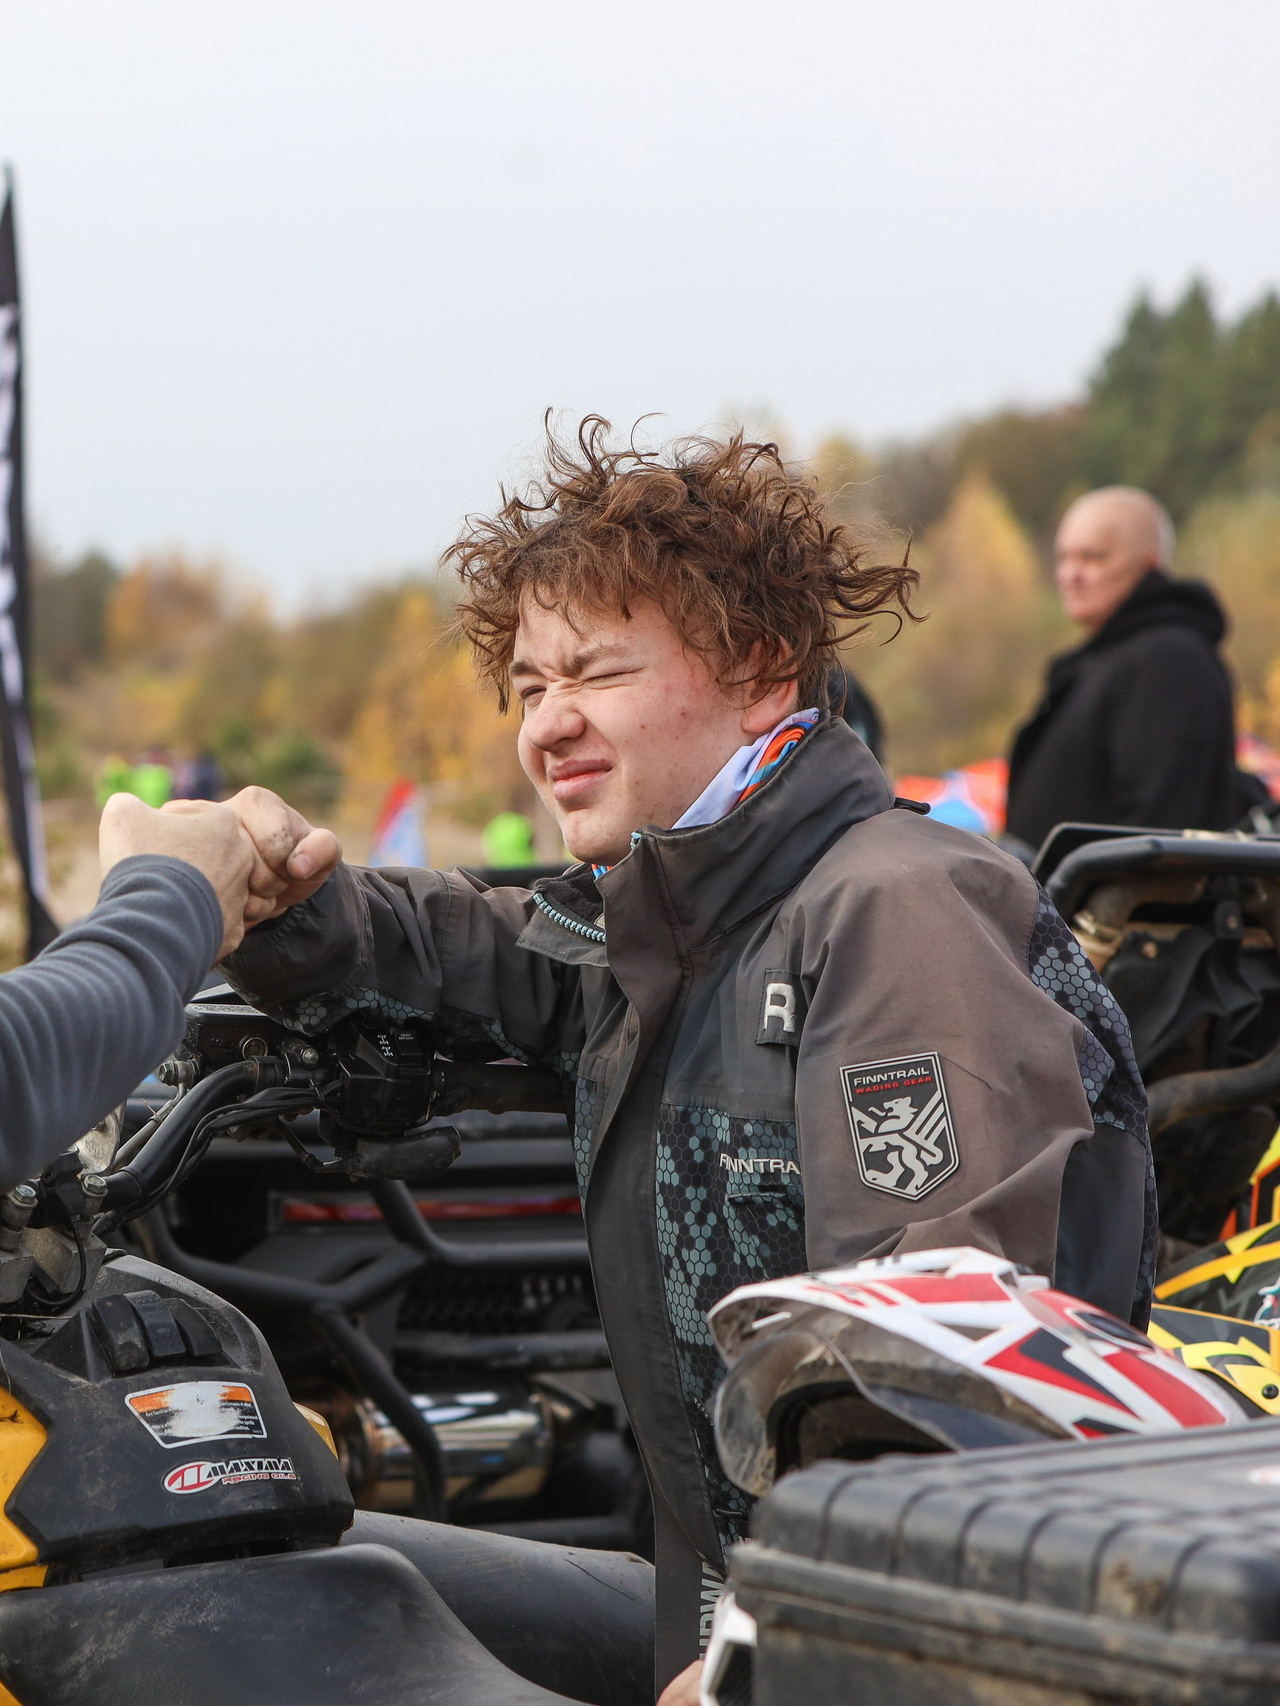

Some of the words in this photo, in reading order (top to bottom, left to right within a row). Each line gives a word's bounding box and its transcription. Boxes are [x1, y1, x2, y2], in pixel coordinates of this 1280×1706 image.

[764, 983, 796, 1032] R
[853, 1067, 930, 1087] FINNTRAIL
[855, 1081, 900, 1094] WADING
[903, 1076, 932, 1086] GEAR
[720, 1153, 802, 1176] FINNTRA
[206, 1459, 293, 1479] MAXIMA
